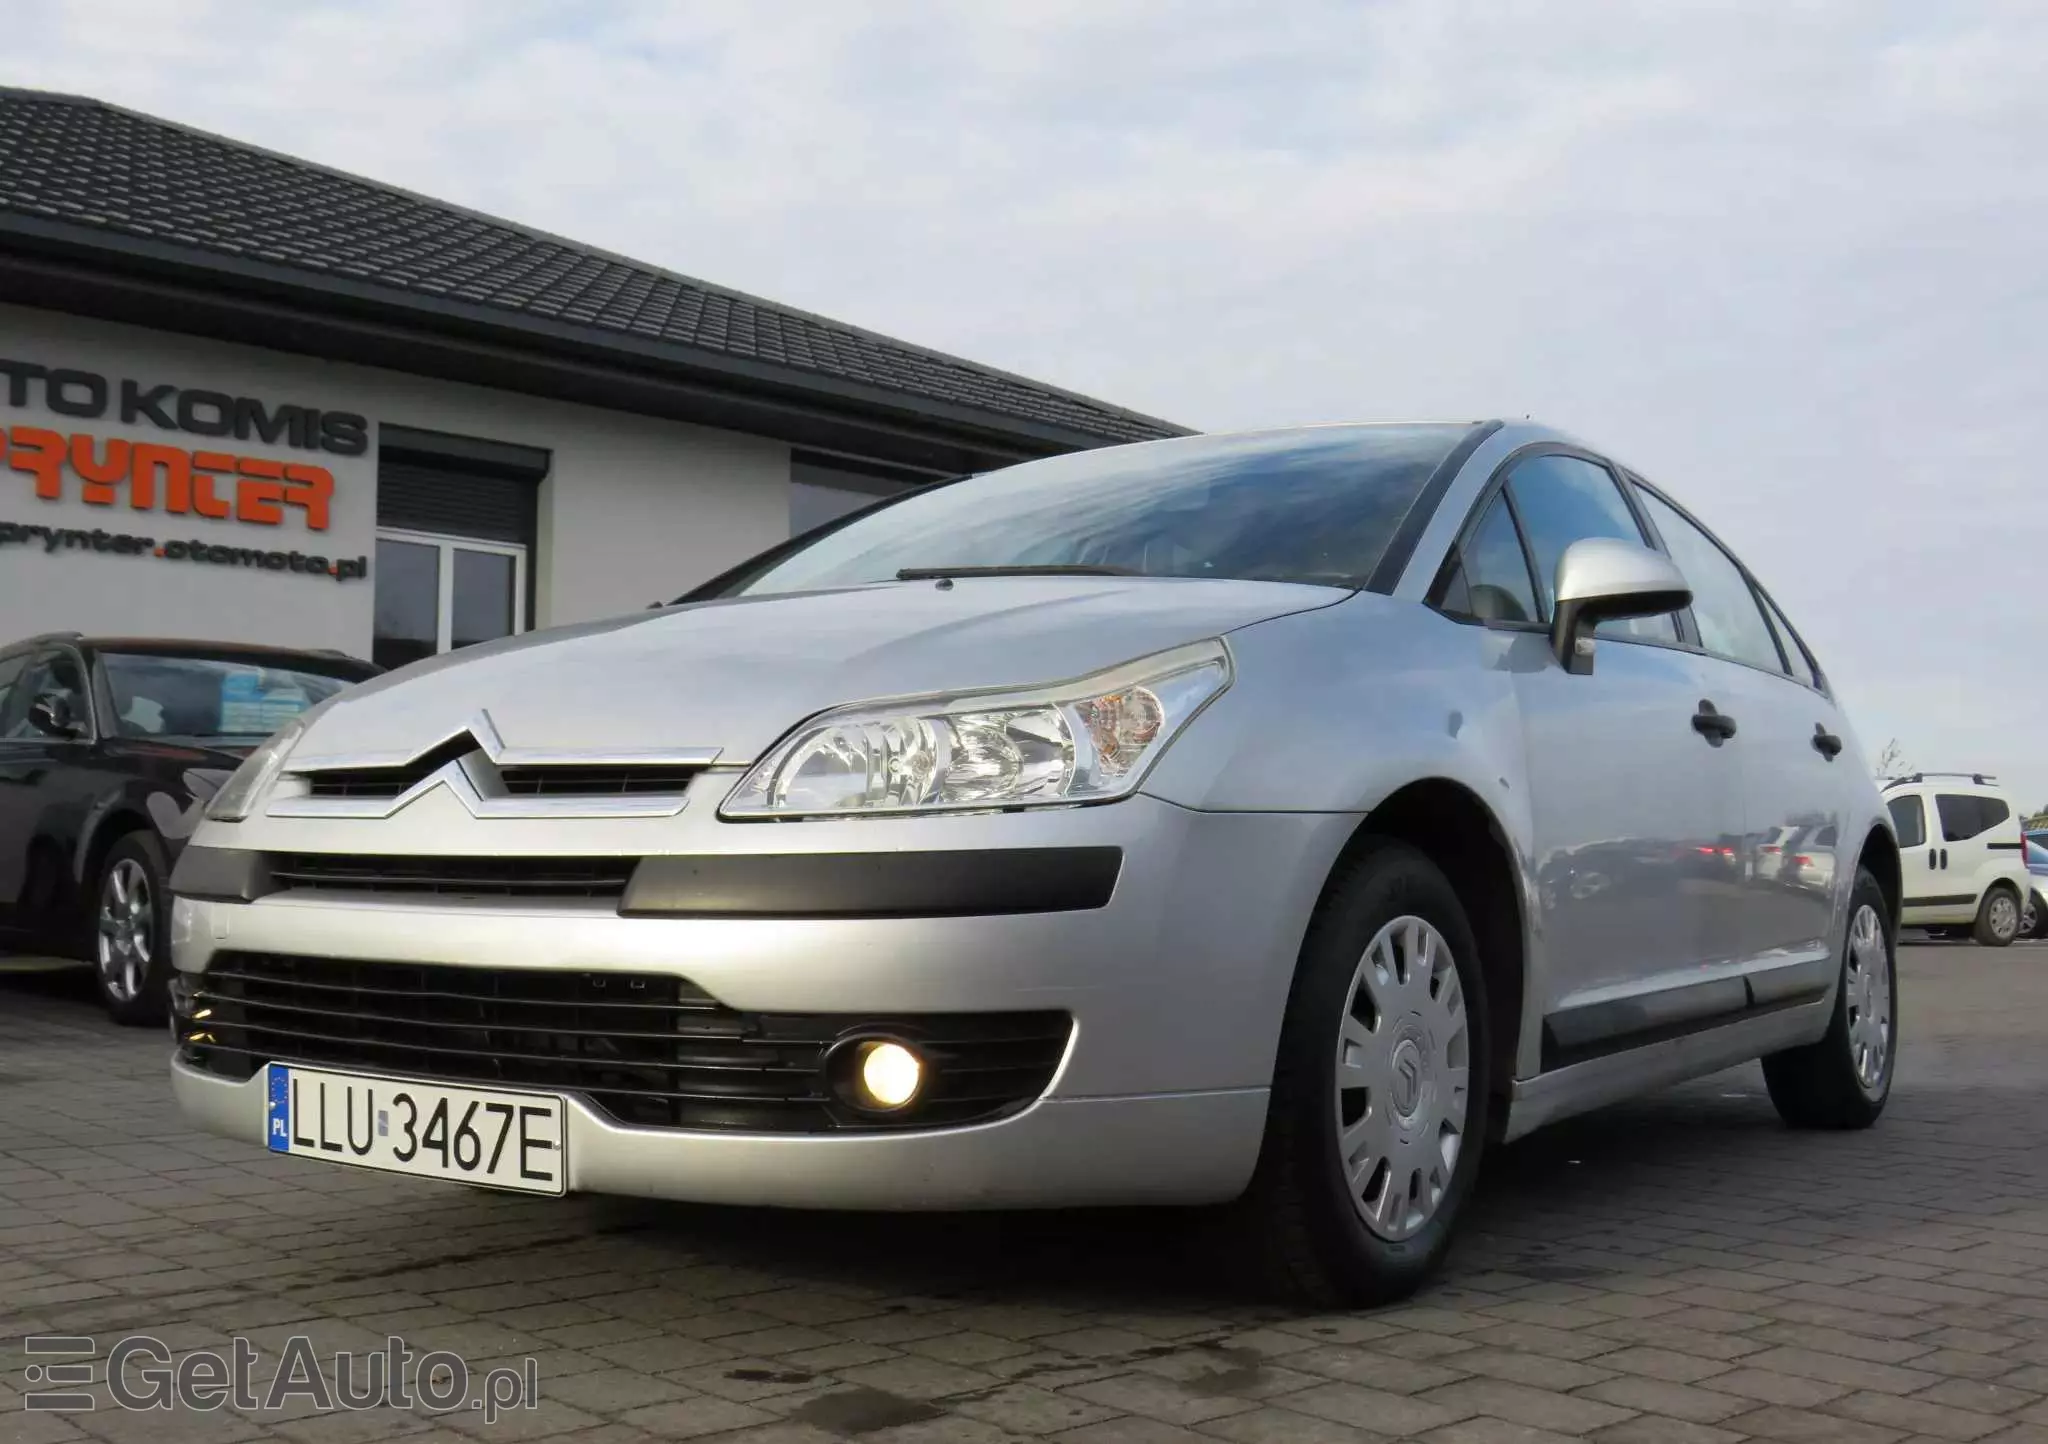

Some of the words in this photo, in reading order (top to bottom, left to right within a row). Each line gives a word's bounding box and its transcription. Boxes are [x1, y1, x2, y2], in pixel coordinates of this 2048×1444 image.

[0, 359, 107, 418] TO
[121, 379, 368, 456] KOMIS
[0, 426, 334, 531] RYNTER
[272, 1118, 288, 1137] PL
[293, 1078, 374, 1156] LLU
[392, 1092, 553, 1182] 3467E
